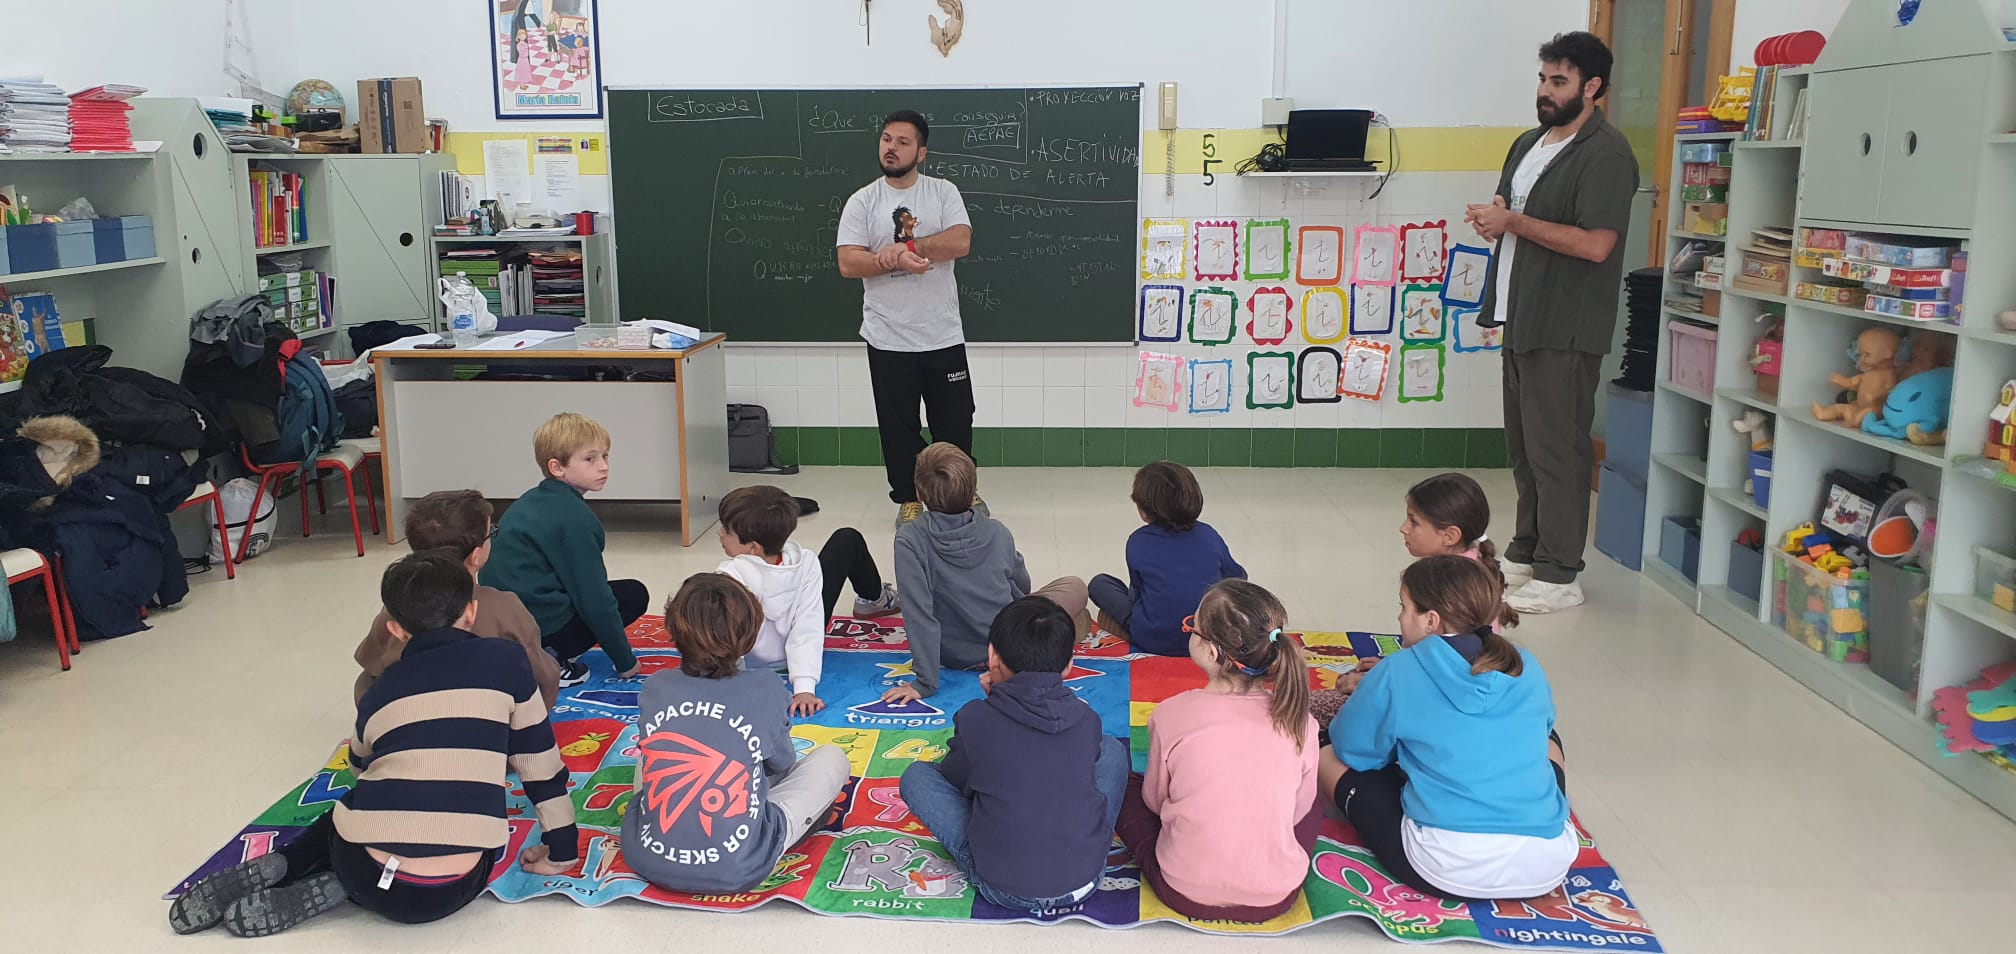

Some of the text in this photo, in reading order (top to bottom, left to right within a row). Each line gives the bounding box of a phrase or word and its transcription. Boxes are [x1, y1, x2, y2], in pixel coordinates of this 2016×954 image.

[966, 126, 1016, 143] AEPAE
[1203, 134, 1216, 158] 5
[936, 161, 1110, 189] ESTADO DE ALERTA
[1203, 160, 1223, 186] 5
[644, 701, 727, 738] APACHE
[845, 711, 947, 727] triangle
[728, 715, 764, 764] JACK
[722, 823, 750, 854] OR
[690, 893, 761, 903] snake
[852, 898, 926, 911] rabbit
[1495, 927, 1648, 946] nightingale
